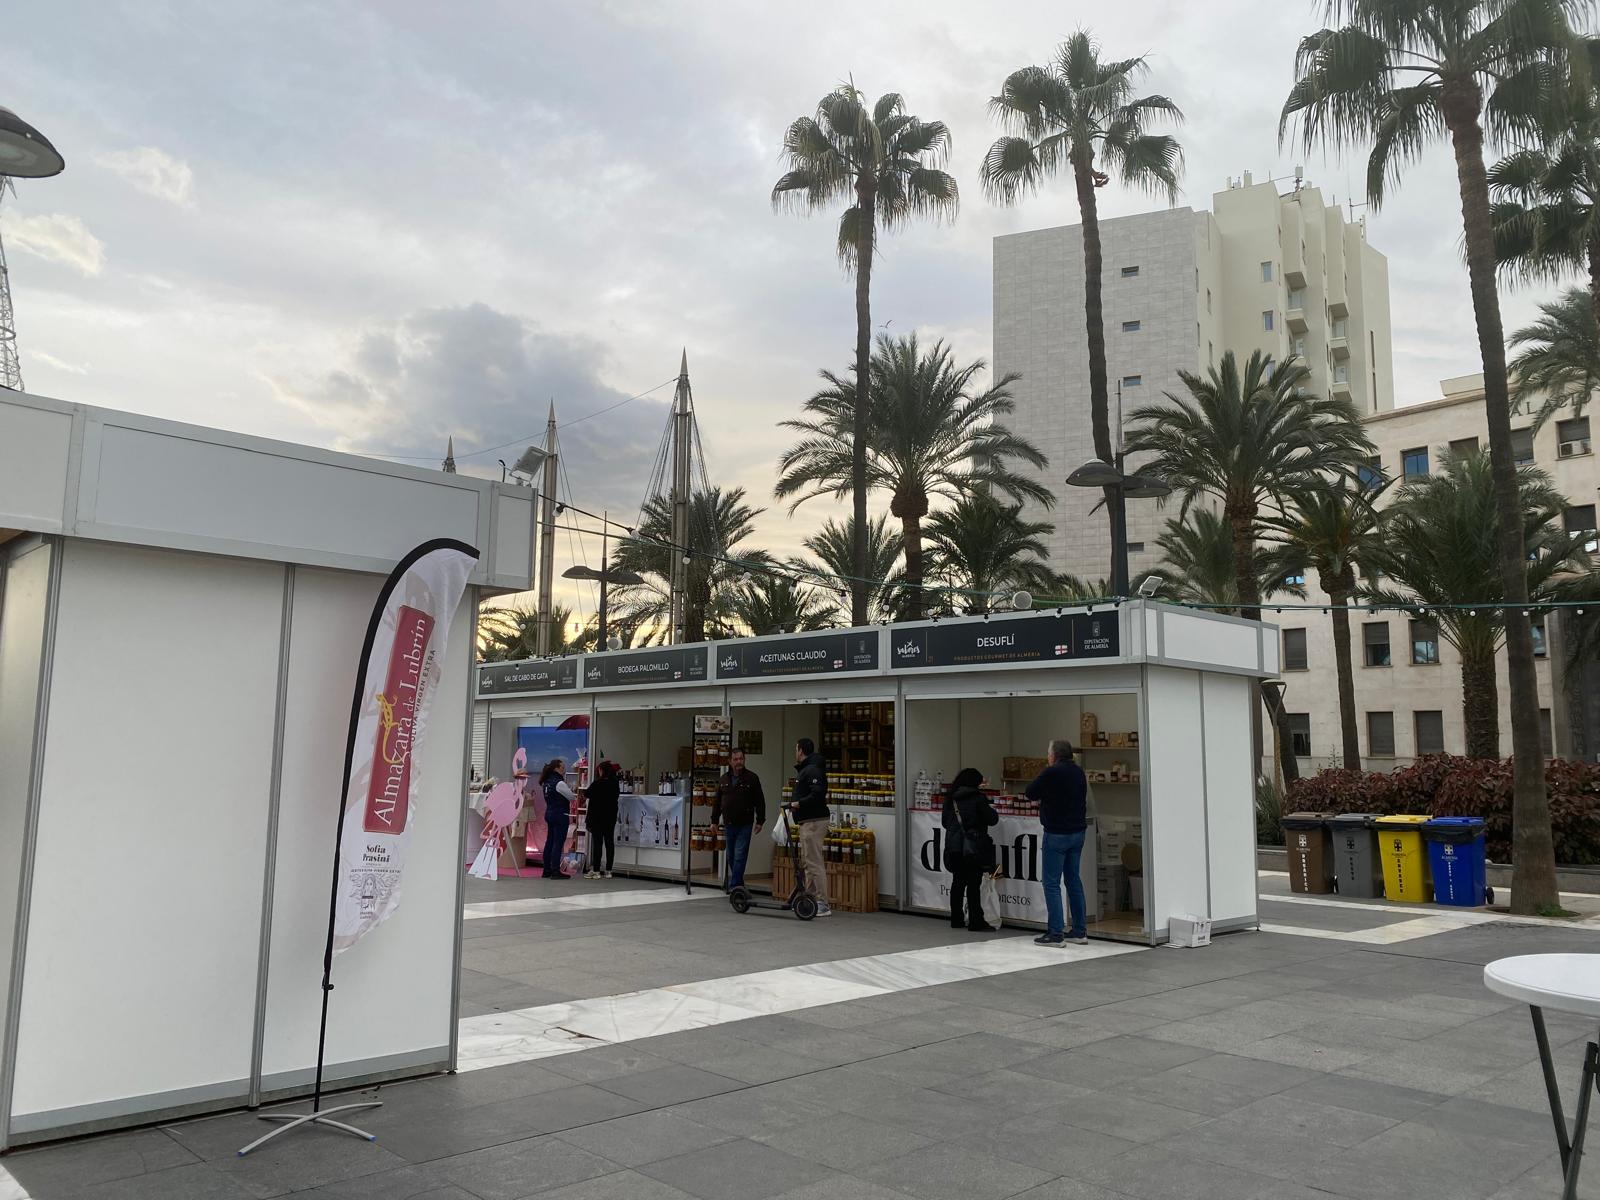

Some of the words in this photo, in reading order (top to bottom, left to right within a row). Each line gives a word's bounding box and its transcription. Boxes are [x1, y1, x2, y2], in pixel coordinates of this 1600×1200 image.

[977, 633, 1015, 647] DESUFLÍ
[399, 618, 426, 690] Lubrín
[759, 652, 795, 663] ACEITUNAS
[796, 650, 827, 661] CLAUDIO
[618, 665, 639, 674] BODEGA
[639, 662, 670, 672] PALOMILLO
[415, 678, 425, 712] VIRGEN
[423, 649, 436, 678] EXTRA
[504, 675, 512, 683] SAL
[512, 674, 518, 682] DE
[537, 672, 549, 680] GATA
[402, 696, 414, 711] de
[373, 716, 412, 827] Almazara
[921, 827, 1043, 883] dufl
[998, 894, 1031, 907] onestos
